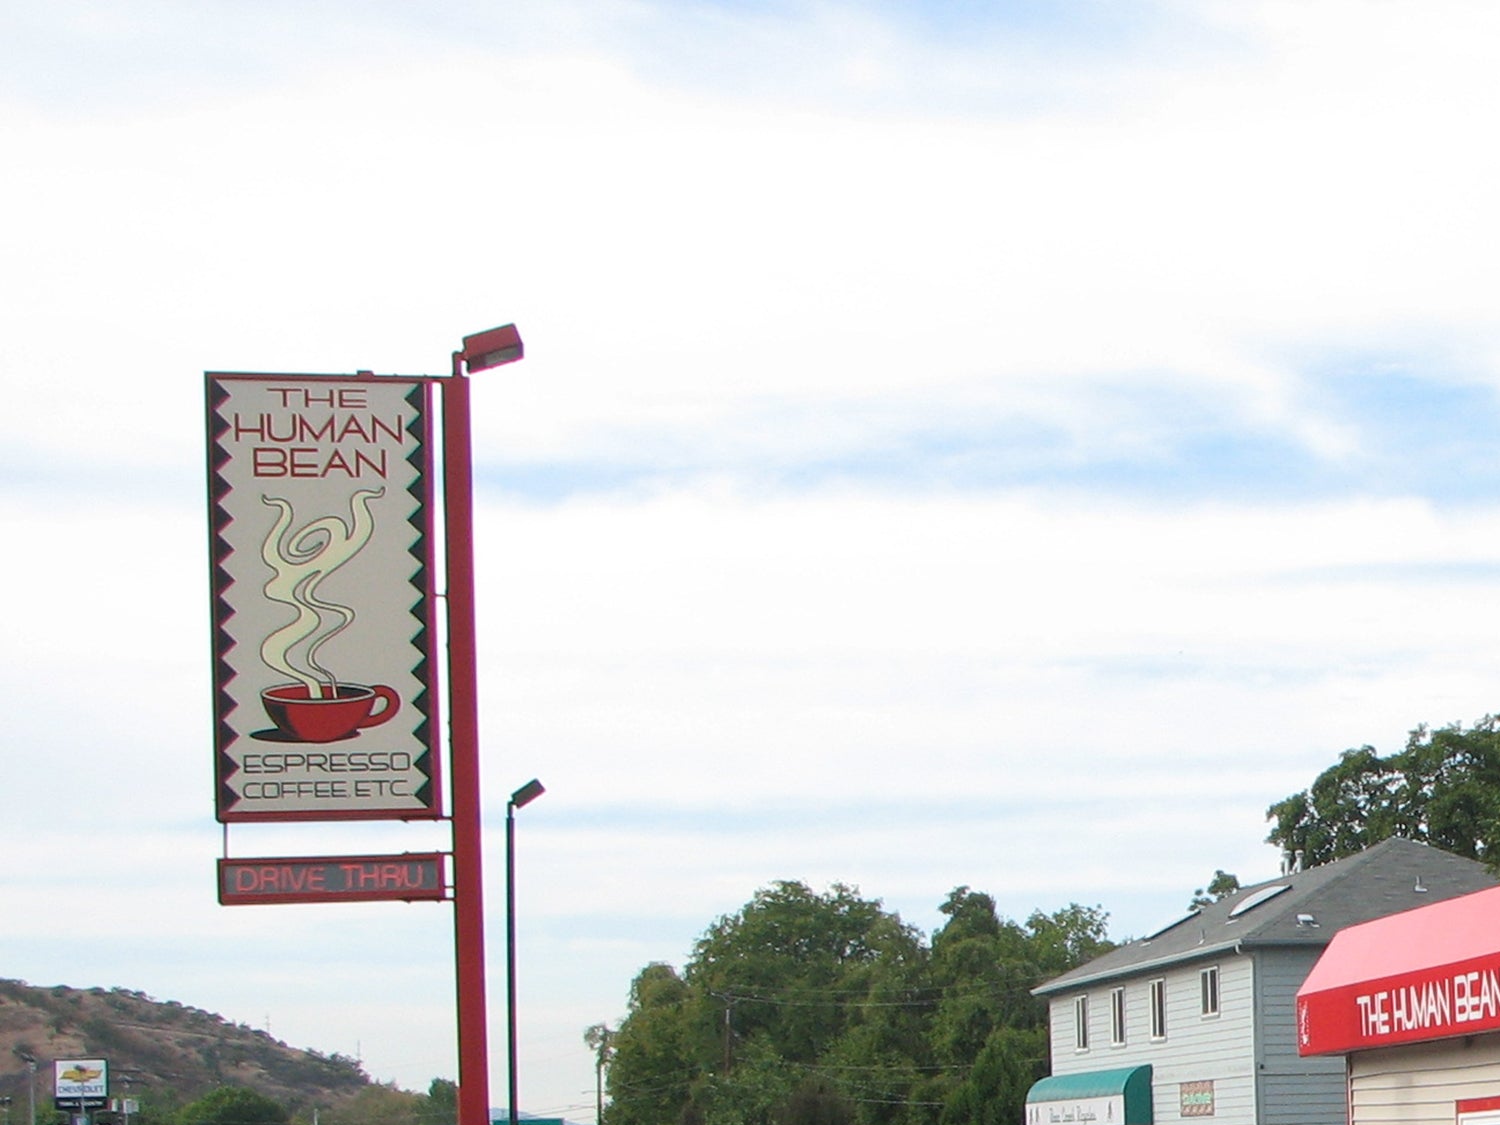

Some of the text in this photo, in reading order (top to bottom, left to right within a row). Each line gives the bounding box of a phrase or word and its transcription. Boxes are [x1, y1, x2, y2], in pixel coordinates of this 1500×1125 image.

[266, 387, 368, 408] THE
[234, 412, 404, 445] HUMAN
[253, 447, 387, 479] BEAN
[242, 751, 412, 774] ESPRESSO
[354, 779, 414, 797] ETC.
[234, 863, 424, 893] DRIVE THRU
[1356, 991, 1390, 1037] THE
[1392, 978, 1452, 1033] HUMAN
